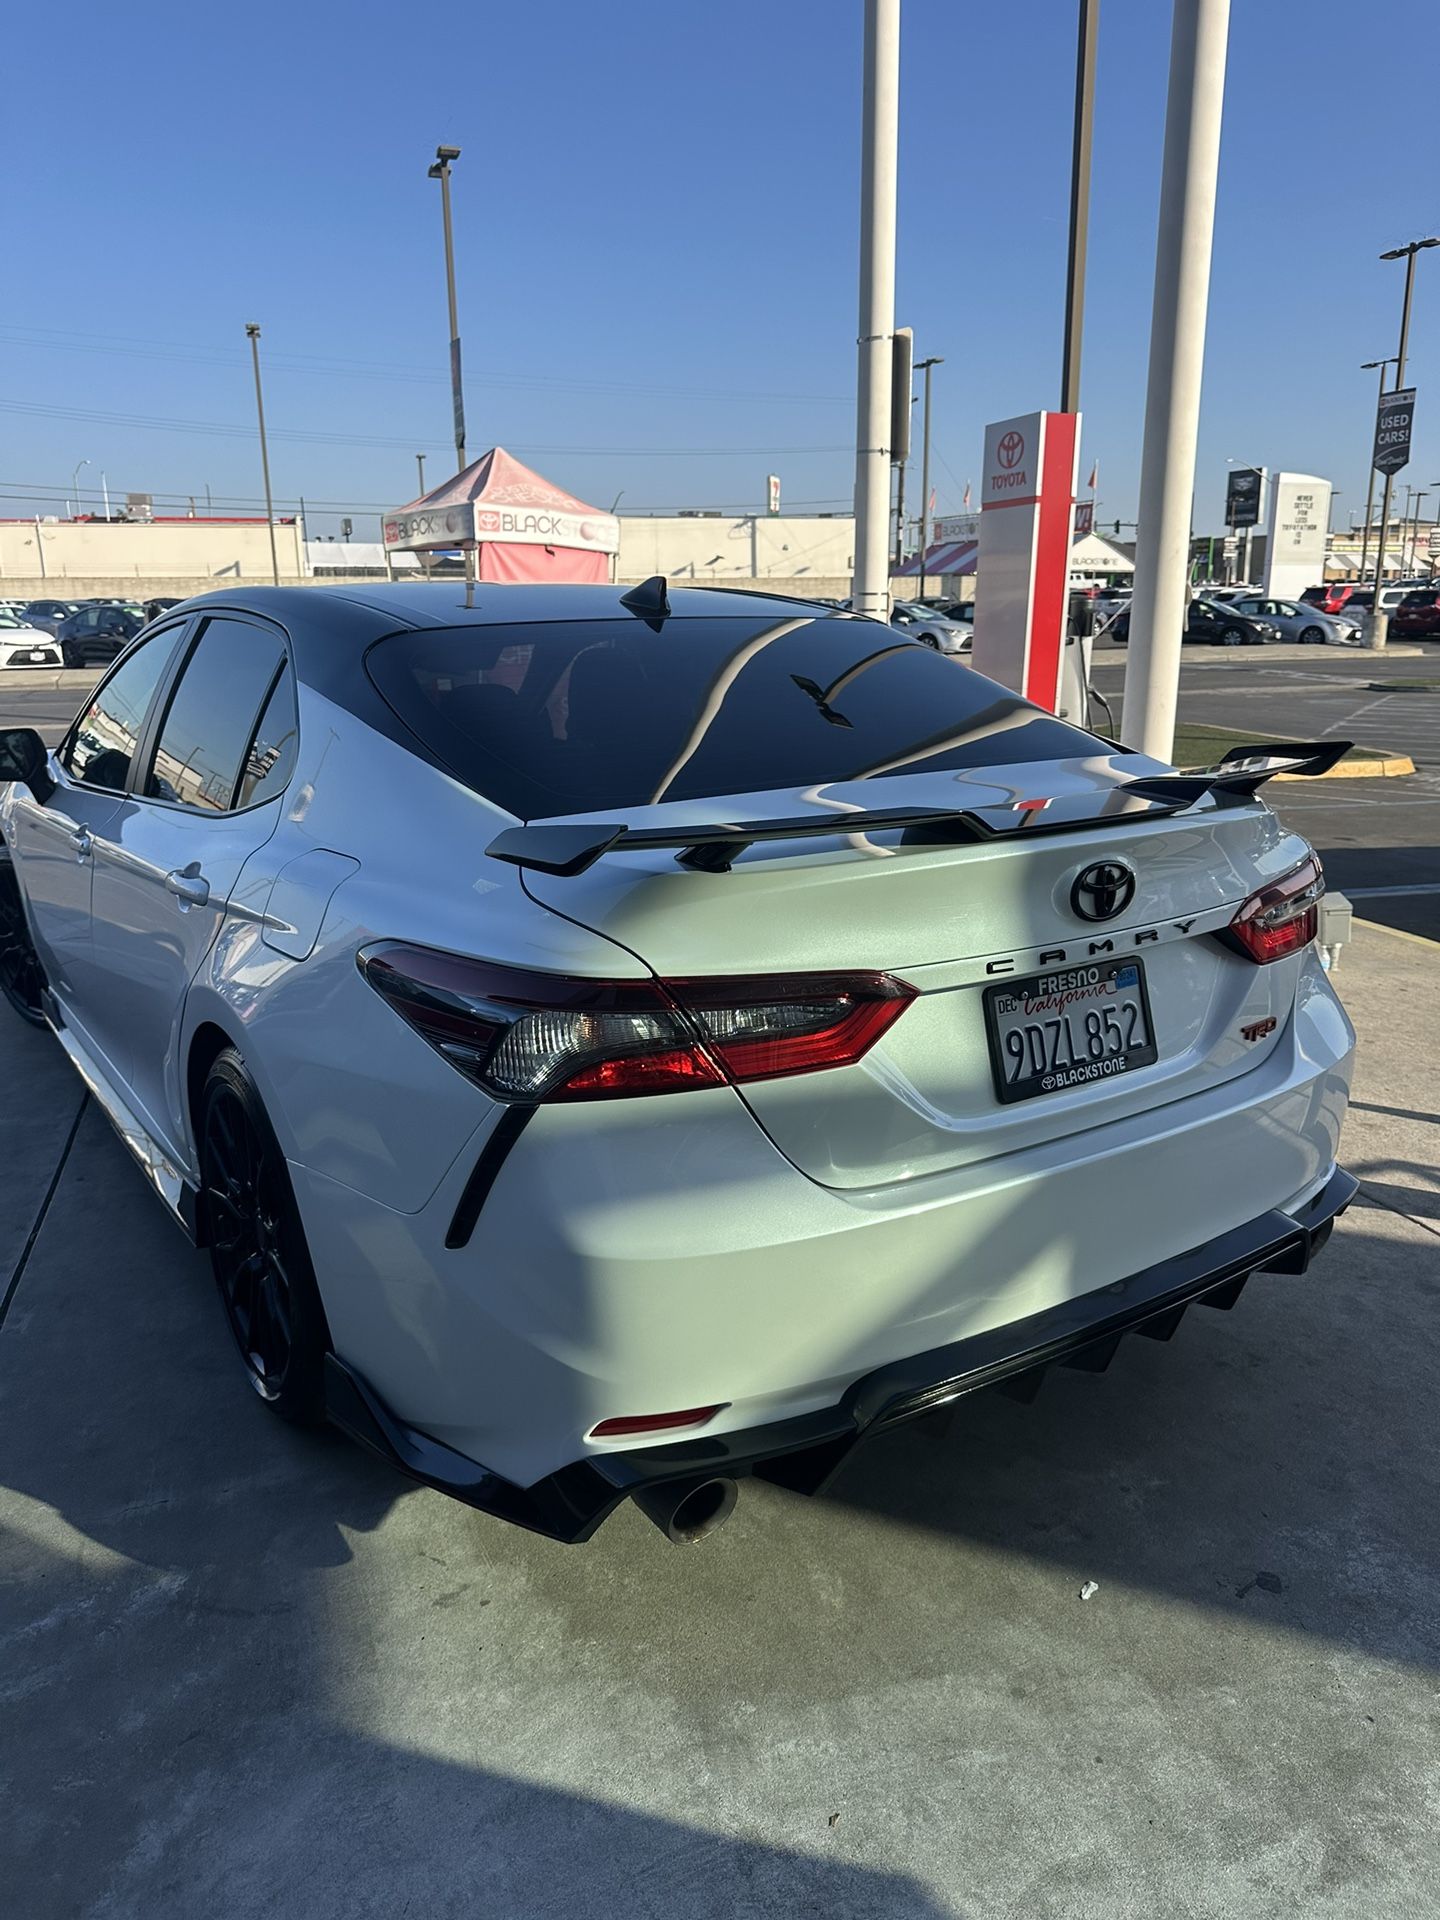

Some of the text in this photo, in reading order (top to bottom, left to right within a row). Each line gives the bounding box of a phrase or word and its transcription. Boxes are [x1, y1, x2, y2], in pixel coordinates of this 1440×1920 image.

[1381, 414, 1409, 429] USED
[1377, 429, 1409, 444] CARS!
[992, 471, 1027, 490] TOYOTA
[986, 918, 1197, 975] CAMRY
[1038, 967, 1099, 995] FRESNO
[998, 997, 1017, 1014] DEC
[1023, 983, 1118, 1016] California
[1005, 999, 1143, 1083] 9DZL852
[1240, 1016, 1277, 1042] TRD
[1056, 1056, 1126, 1087] BLACKSTONE
